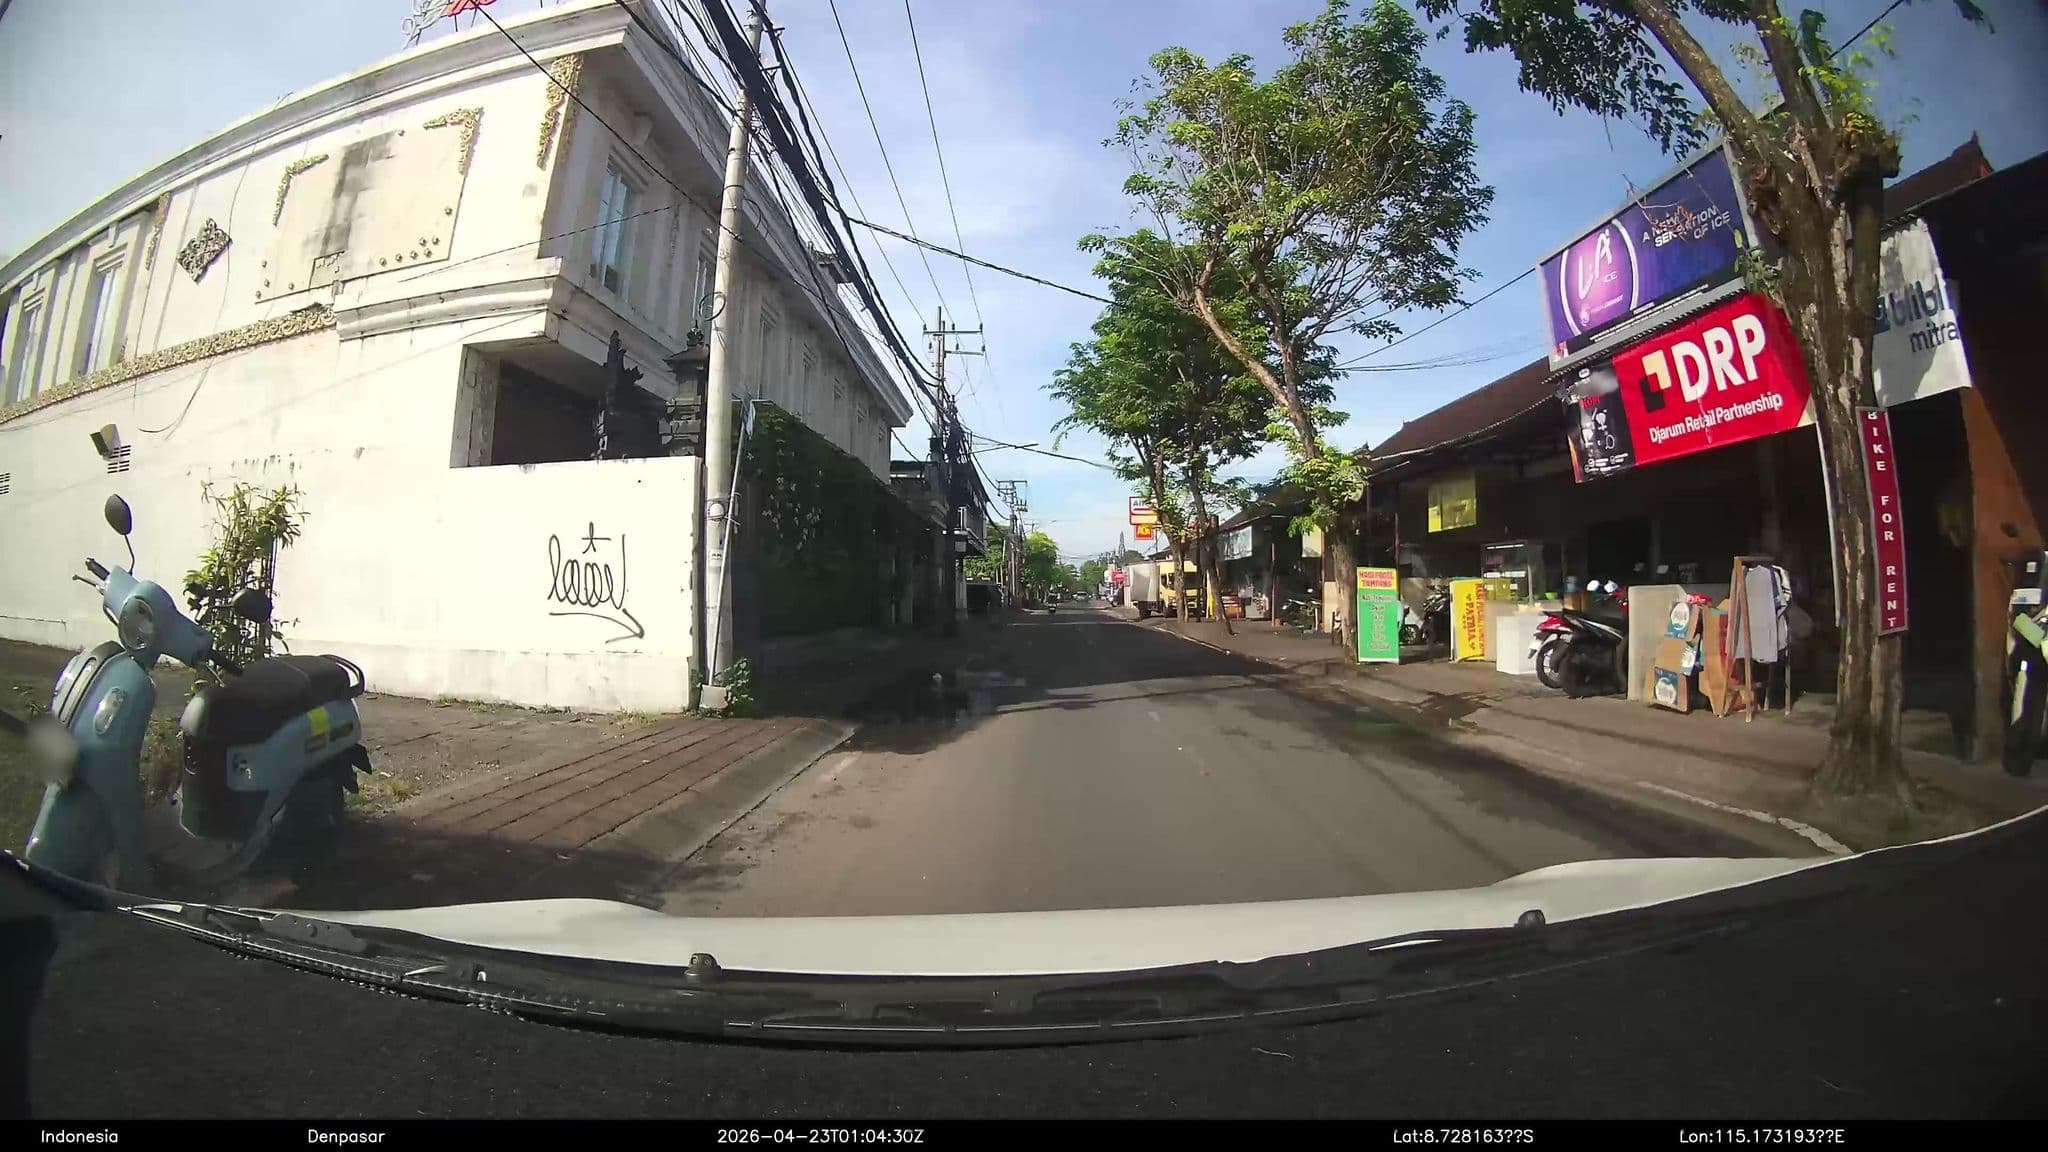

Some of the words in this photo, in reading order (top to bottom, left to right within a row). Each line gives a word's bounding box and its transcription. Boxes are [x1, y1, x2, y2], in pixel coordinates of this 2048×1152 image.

[1643, 231, 1651, 243] A
[1694, 223, 1708, 239] OF
[1711, 211, 1731, 231] ICE
[1888, 274, 1945, 326] blibl
[1671, 313, 1766, 403] DRP
[1910, 321, 1960, 352] mitra
[1649, 421, 1684, 443] Djarum
[1685, 411, 1716, 433] Retail
[1717, 392, 1784, 423] Partnership
[1867, 411, 1887, 471] BIKE
[1881, 495, 1894, 541] FOR
[1886, 565, 1897, 628] RENT
